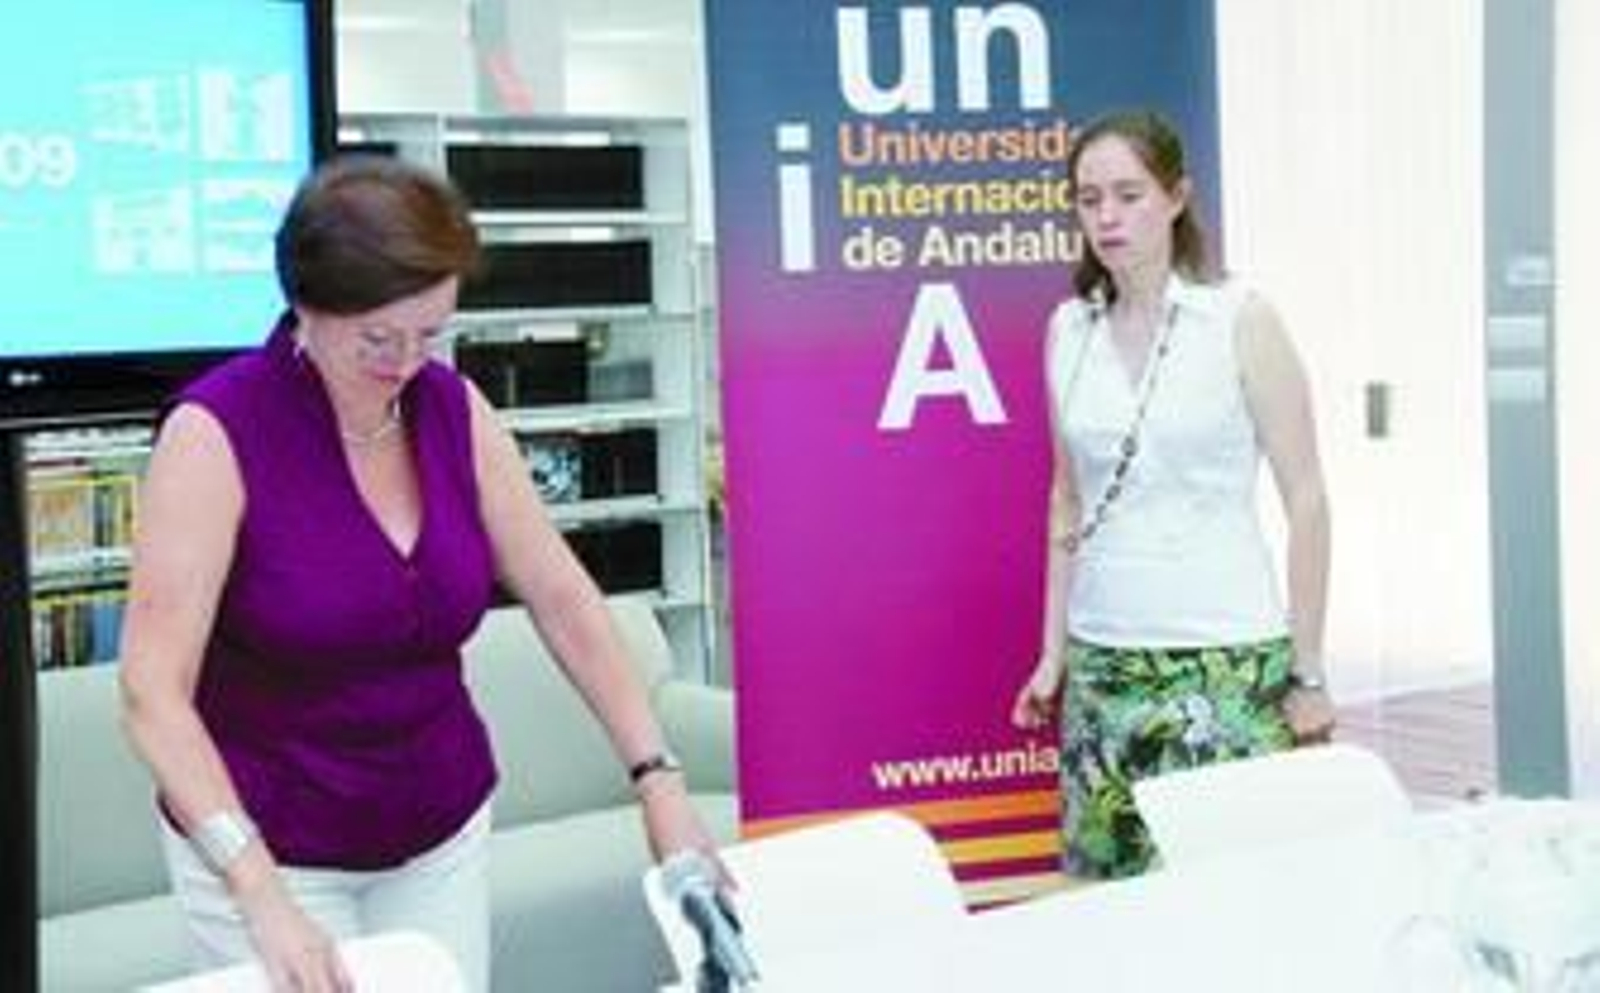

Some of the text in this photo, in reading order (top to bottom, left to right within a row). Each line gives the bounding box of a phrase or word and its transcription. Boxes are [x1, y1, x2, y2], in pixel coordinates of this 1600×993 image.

[837, 3, 1051, 114] un
[777, 122, 815, 272] i
[839, 121, 1077, 165] Universid
[842, 220, 1084, 269] de Andalu
[876, 284, 1010, 430] A
